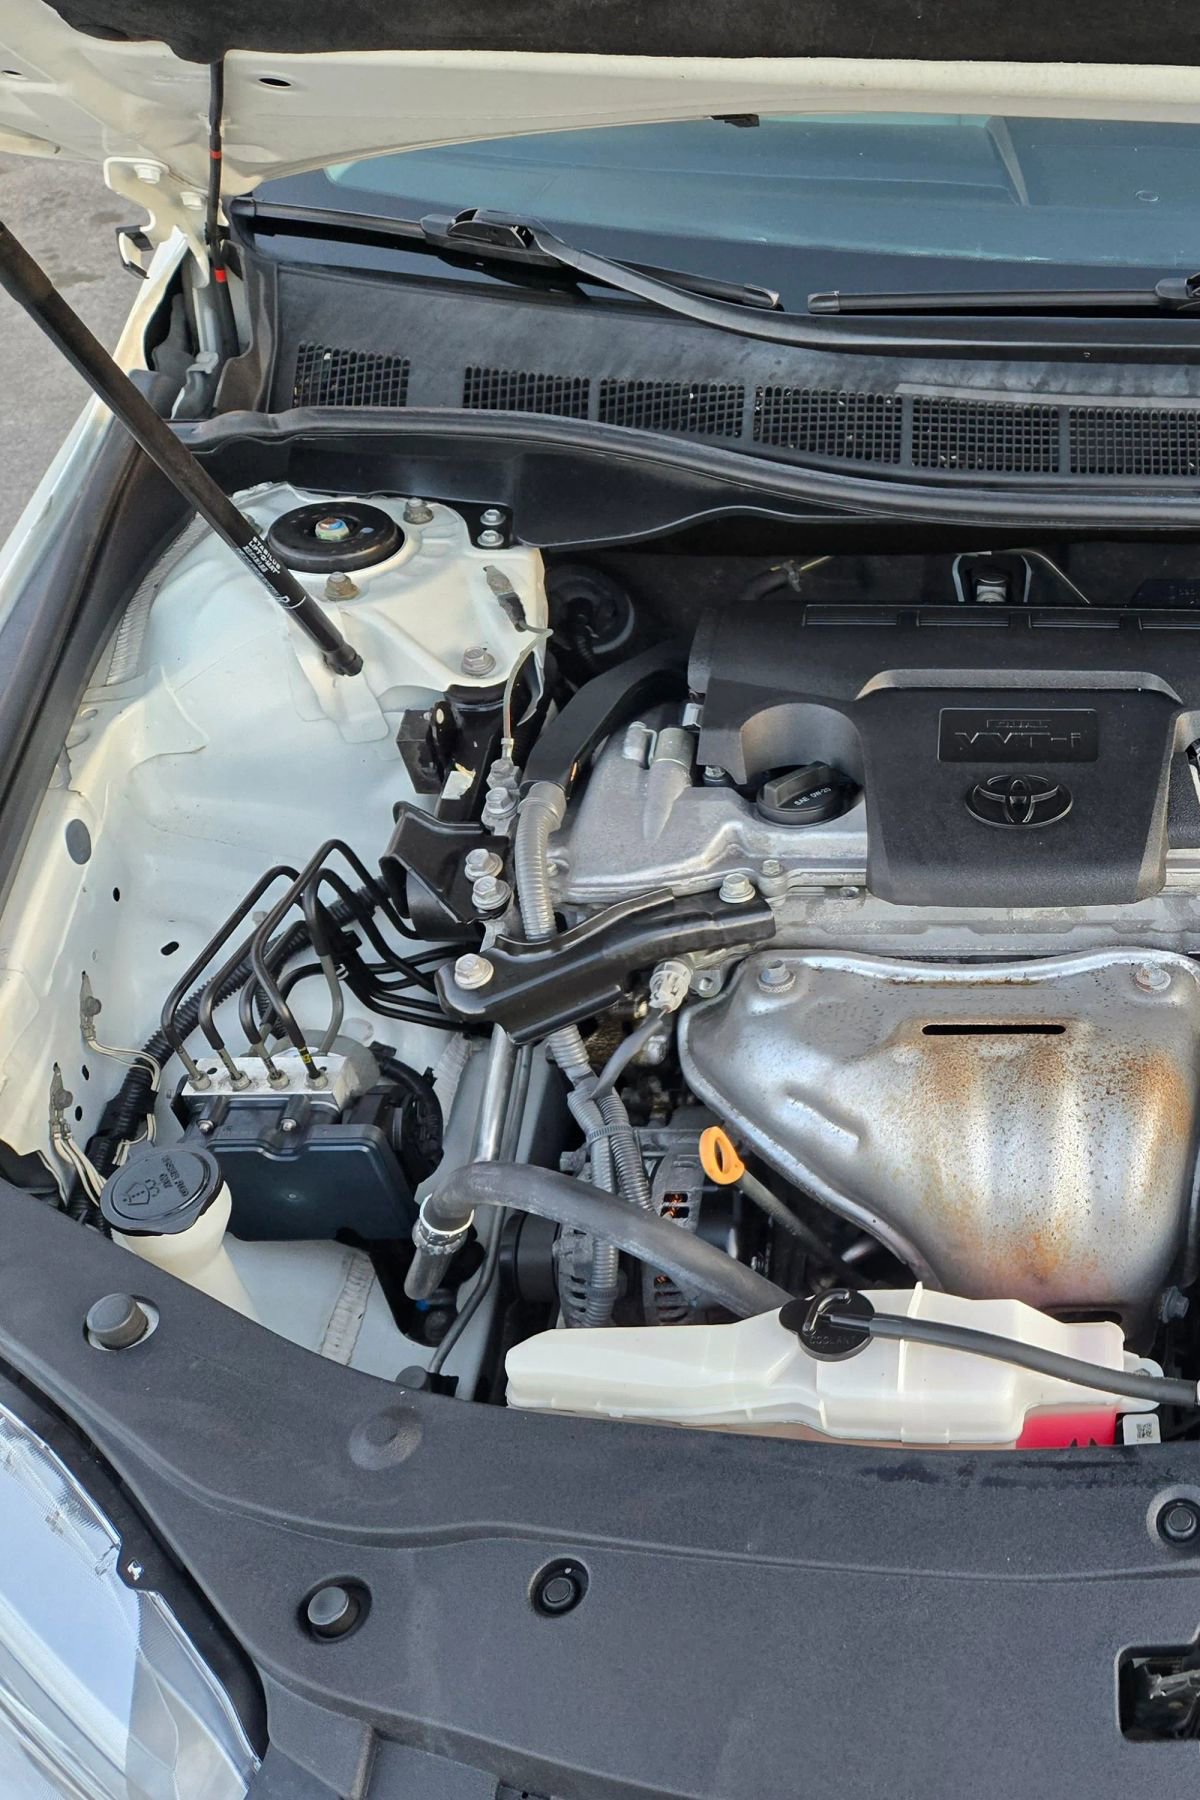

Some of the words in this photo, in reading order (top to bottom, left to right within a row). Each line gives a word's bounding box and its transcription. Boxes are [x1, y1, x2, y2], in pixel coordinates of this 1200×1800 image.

[252, 535, 281, 570] STABILUS
[794, 796, 810, 806] SAE
[810, 787, 832, 798] 0W-20
